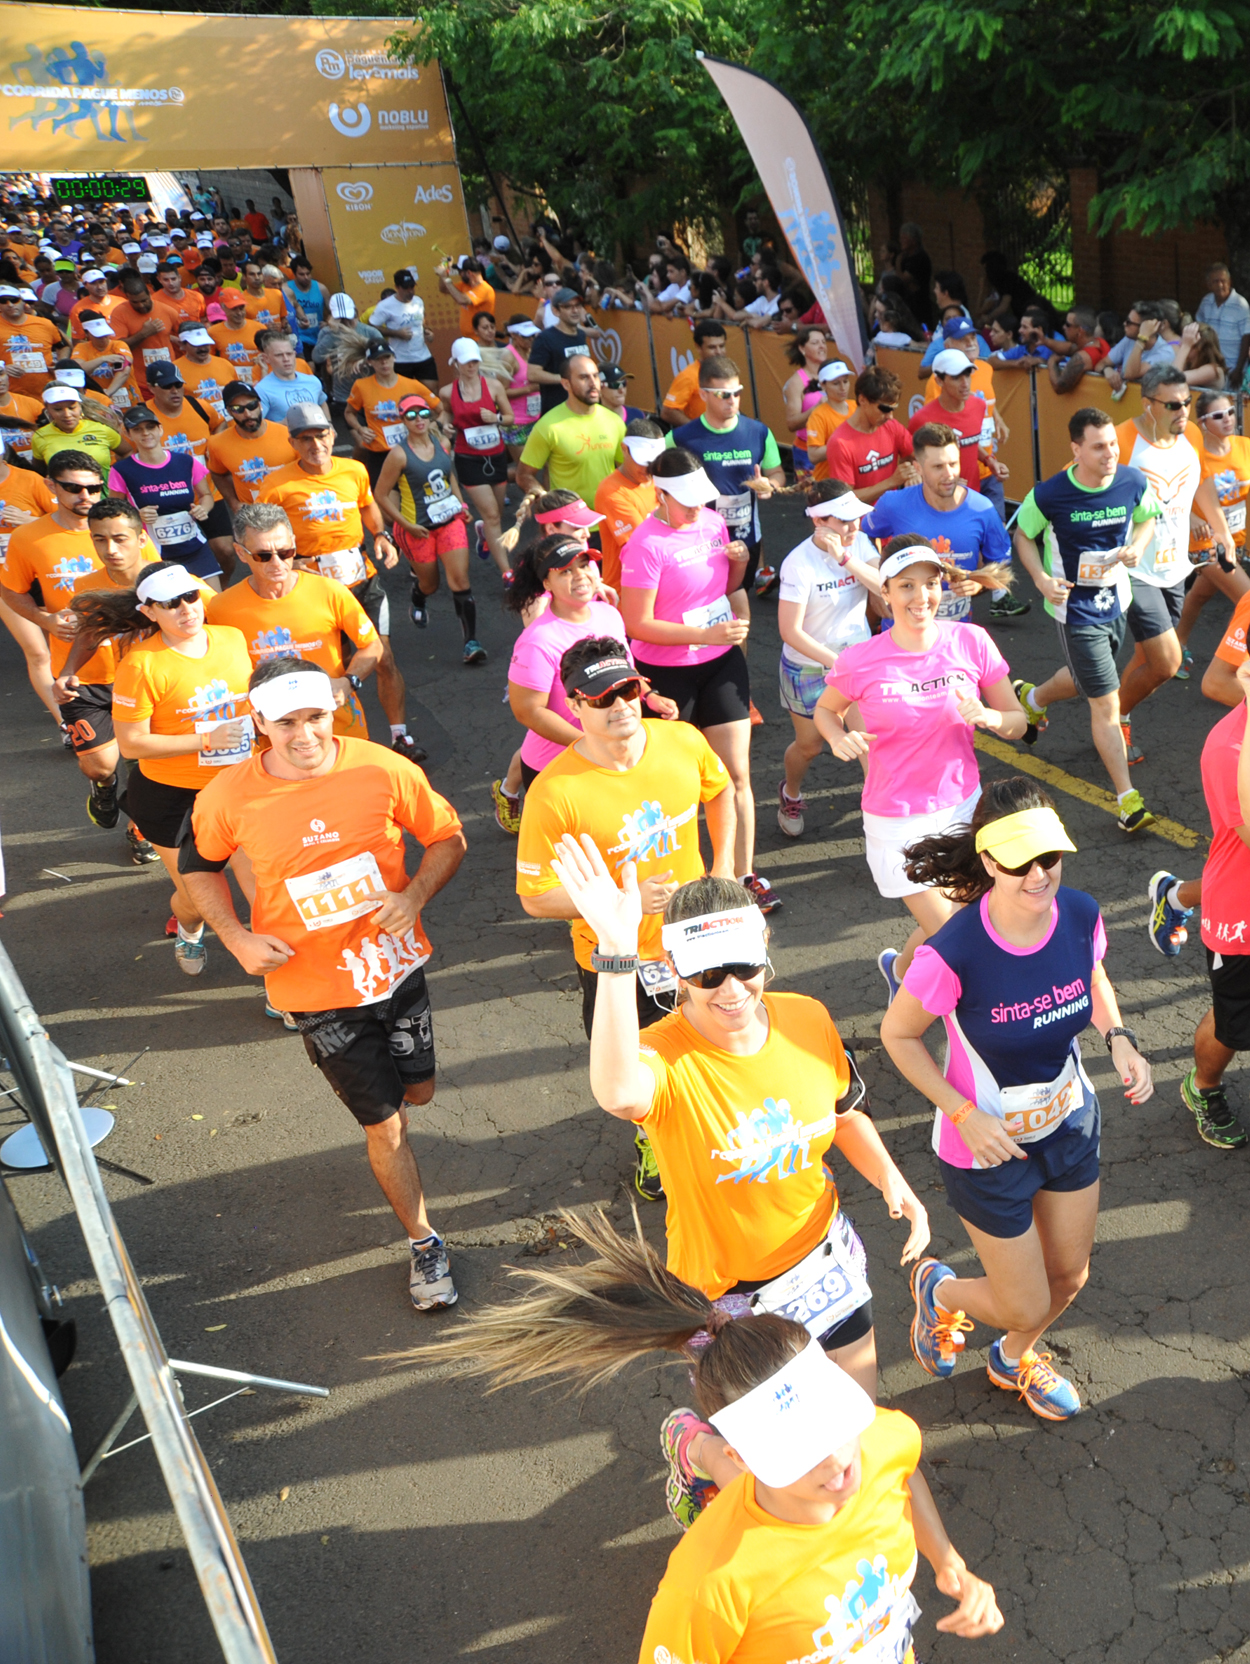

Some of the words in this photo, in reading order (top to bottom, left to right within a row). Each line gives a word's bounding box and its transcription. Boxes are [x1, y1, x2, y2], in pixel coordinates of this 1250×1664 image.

[56, 179, 146, 199] 00:00:29
[414, 184, 453, 204] AdeS
[345, 203, 372, 211] KIBON
[703, 451, 733, 461] sinta-se
[733, 449, 752, 459] bem
[140, 482, 169, 493] sinta-se
[170, 481, 188, 490] bem
[160, 488, 189, 497] RUNNING
[718, 505, 751, 519] 6540
[1070, 508, 1105, 522] sinta-se
[1106, 505, 1127, 516] bem
[157, 523, 192, 539] 6276
[1091, 516, 1127, 528] RUNNING
[816, 575, 859, 592] TRIACT
[936, 598, 967, 617] 517
[880, 674, 965, 696] TRACTION
[67, 718, 97, 747] 20
[302, 831, 339, 844] SUZANO
[302, 878, 372, 917] 1111
[684, 916, 744, 936] TRIACTION
[991, 993, 1052, 1023] sinta-se
[1052, 978, 1086, 1005] bem
[1033, 995, 1089, 1029] RUNNING
[1008, 1086, 1073, 1134] 1042
[778, 1270, 846, 1322] 269
